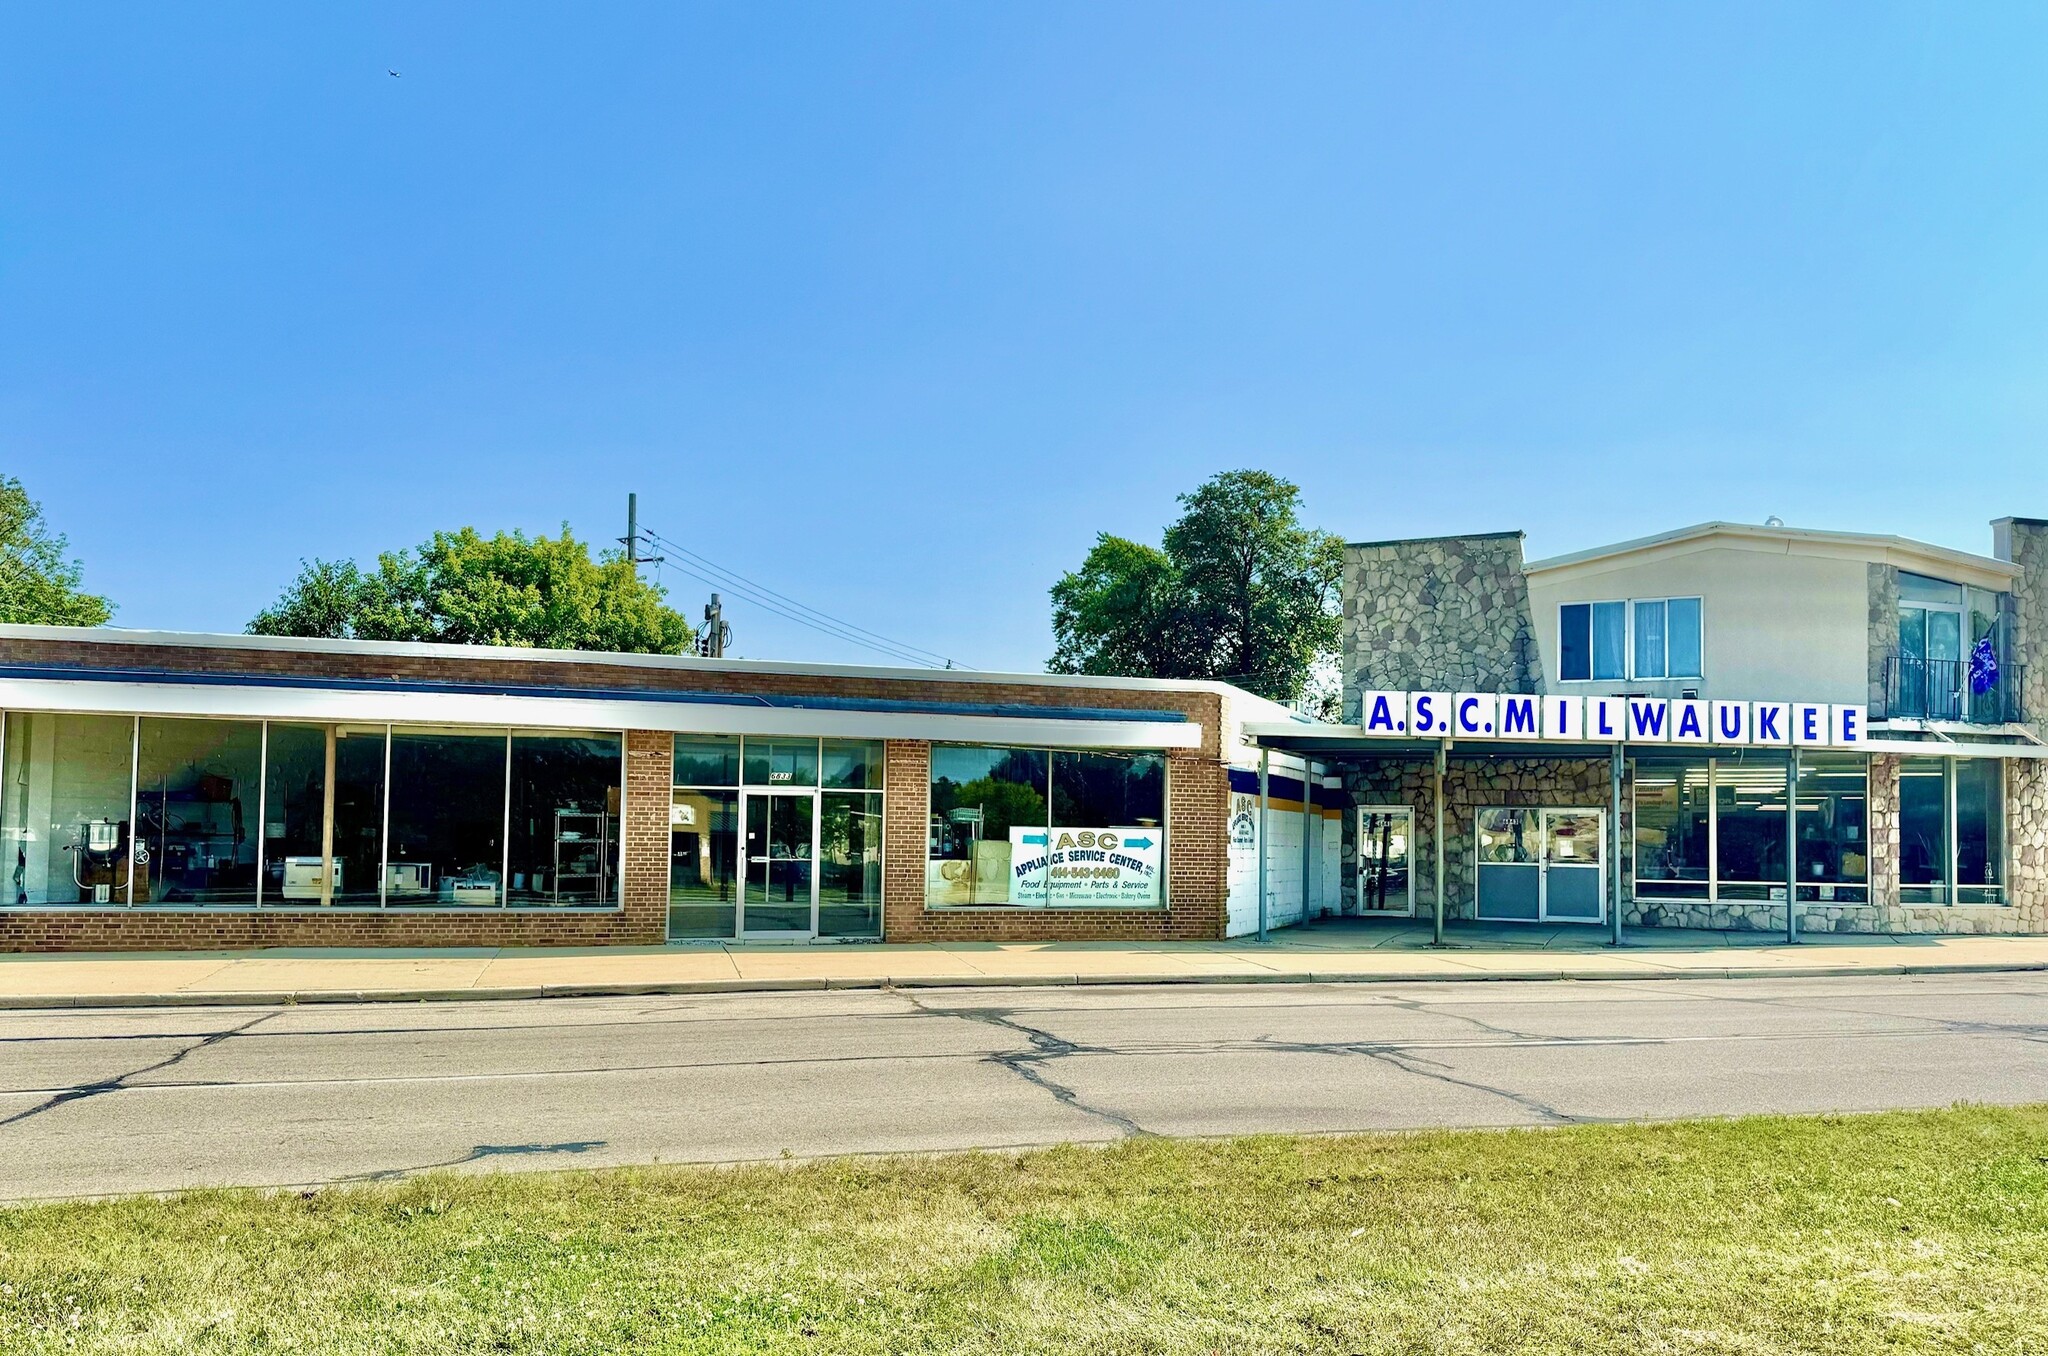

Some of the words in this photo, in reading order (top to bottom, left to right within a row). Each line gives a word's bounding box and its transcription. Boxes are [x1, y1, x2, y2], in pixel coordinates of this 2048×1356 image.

[1236, 796, 1252, 816] ASC
[1056, 831, 1118, 850] ASC
[1068, 850, 1106, 862] SERVICE
[1021, 880, 1041, 888] Food
[1090, 880, 1109, 889] Parts
[1112, 880, 1119, 889] &
[1121, 880, 1149, 889] Service
